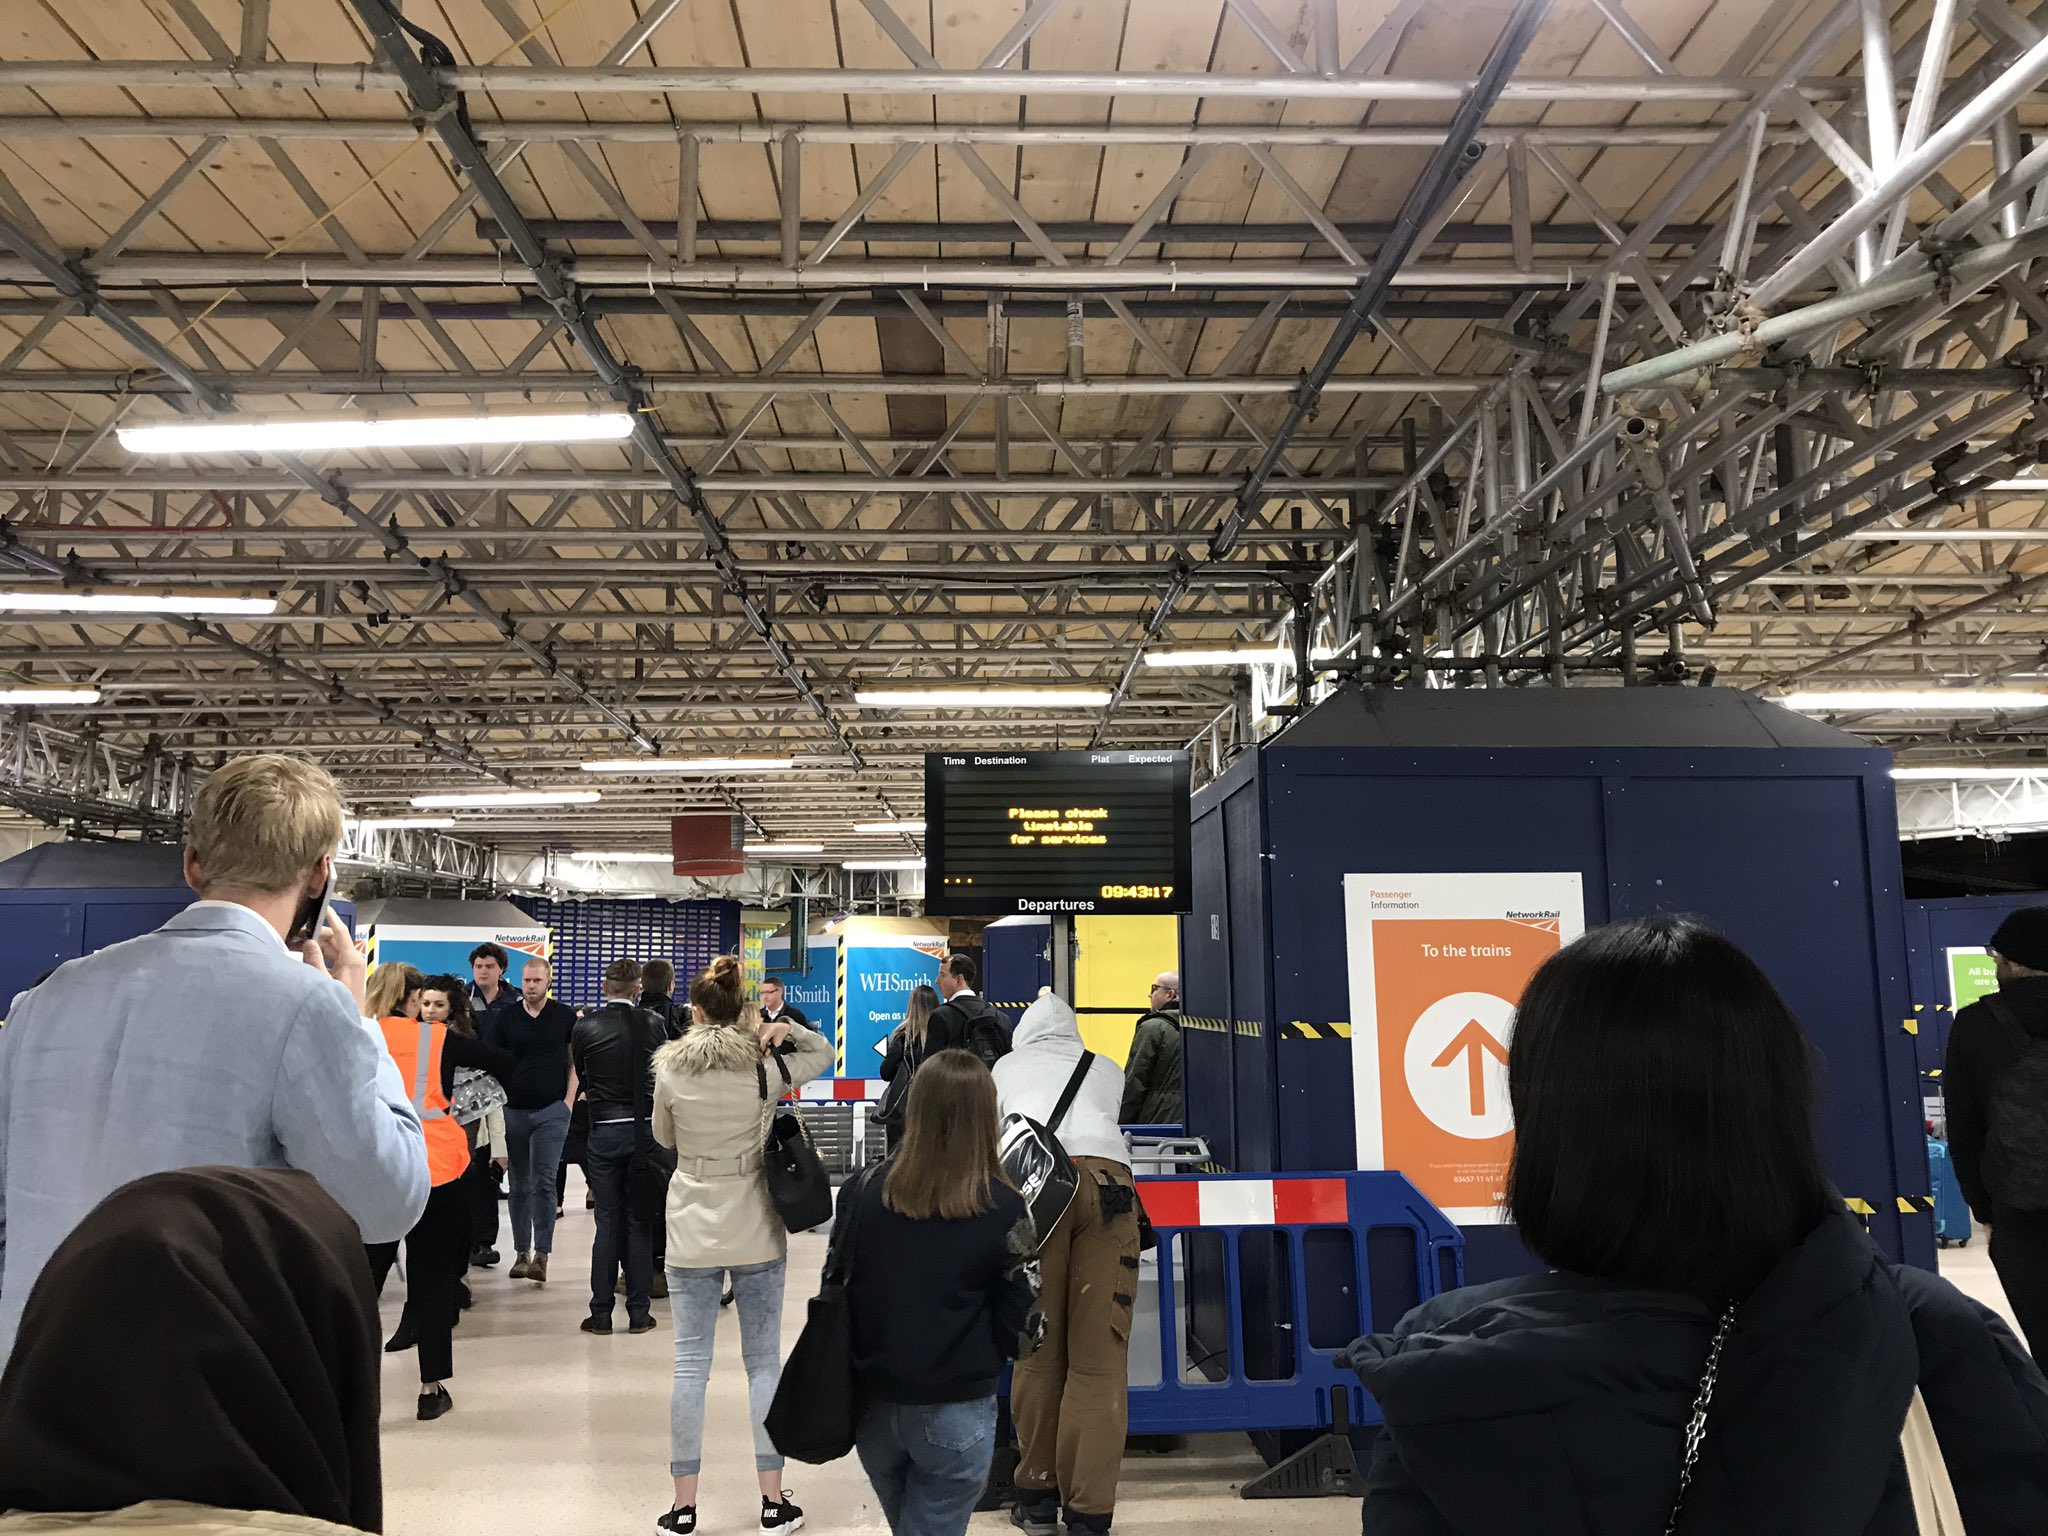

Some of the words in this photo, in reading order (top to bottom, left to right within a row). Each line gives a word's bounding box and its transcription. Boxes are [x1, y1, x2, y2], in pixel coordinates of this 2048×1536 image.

[943, 757, 966, 765] Time
[974, 756, 1027, 765] Destination
[1091, 755, 1110, 763] Plat
[1128, 754, 1173, 764] Expected
[1008, 808, 1060, 818] Please
[1064, 807, 1109, 818] check
[1023, 820, 1094, 831] timetable
[1010, 833, 1035, 844] for
[1040, 833, 1108, 844] services
[1101, 885, 1174, 898] 09:43:17
[1370, 890, 1412, 900] Passenger
[1018, 899, 1095, 913] Departures
[1371, 901, 1420, 909] Information
[1506, 910, 1560, 918] NetworkRail
[1421, 944, 1439, 957] To
[1442, 944, 1467, 957] the
[1470, 944, 1512, 957] trains
[1968, 967, 1981, 976] All
[859, 973, 932, 992] WHSmith
[784, 985, 831, 1003] HSmith
[868, 1010, 891, 1023] Open
[891, 1011, 902, 1020] as
[764, 1508, 779, 1518] NIKE
[677, 1514, 693, 1525] NIKE
